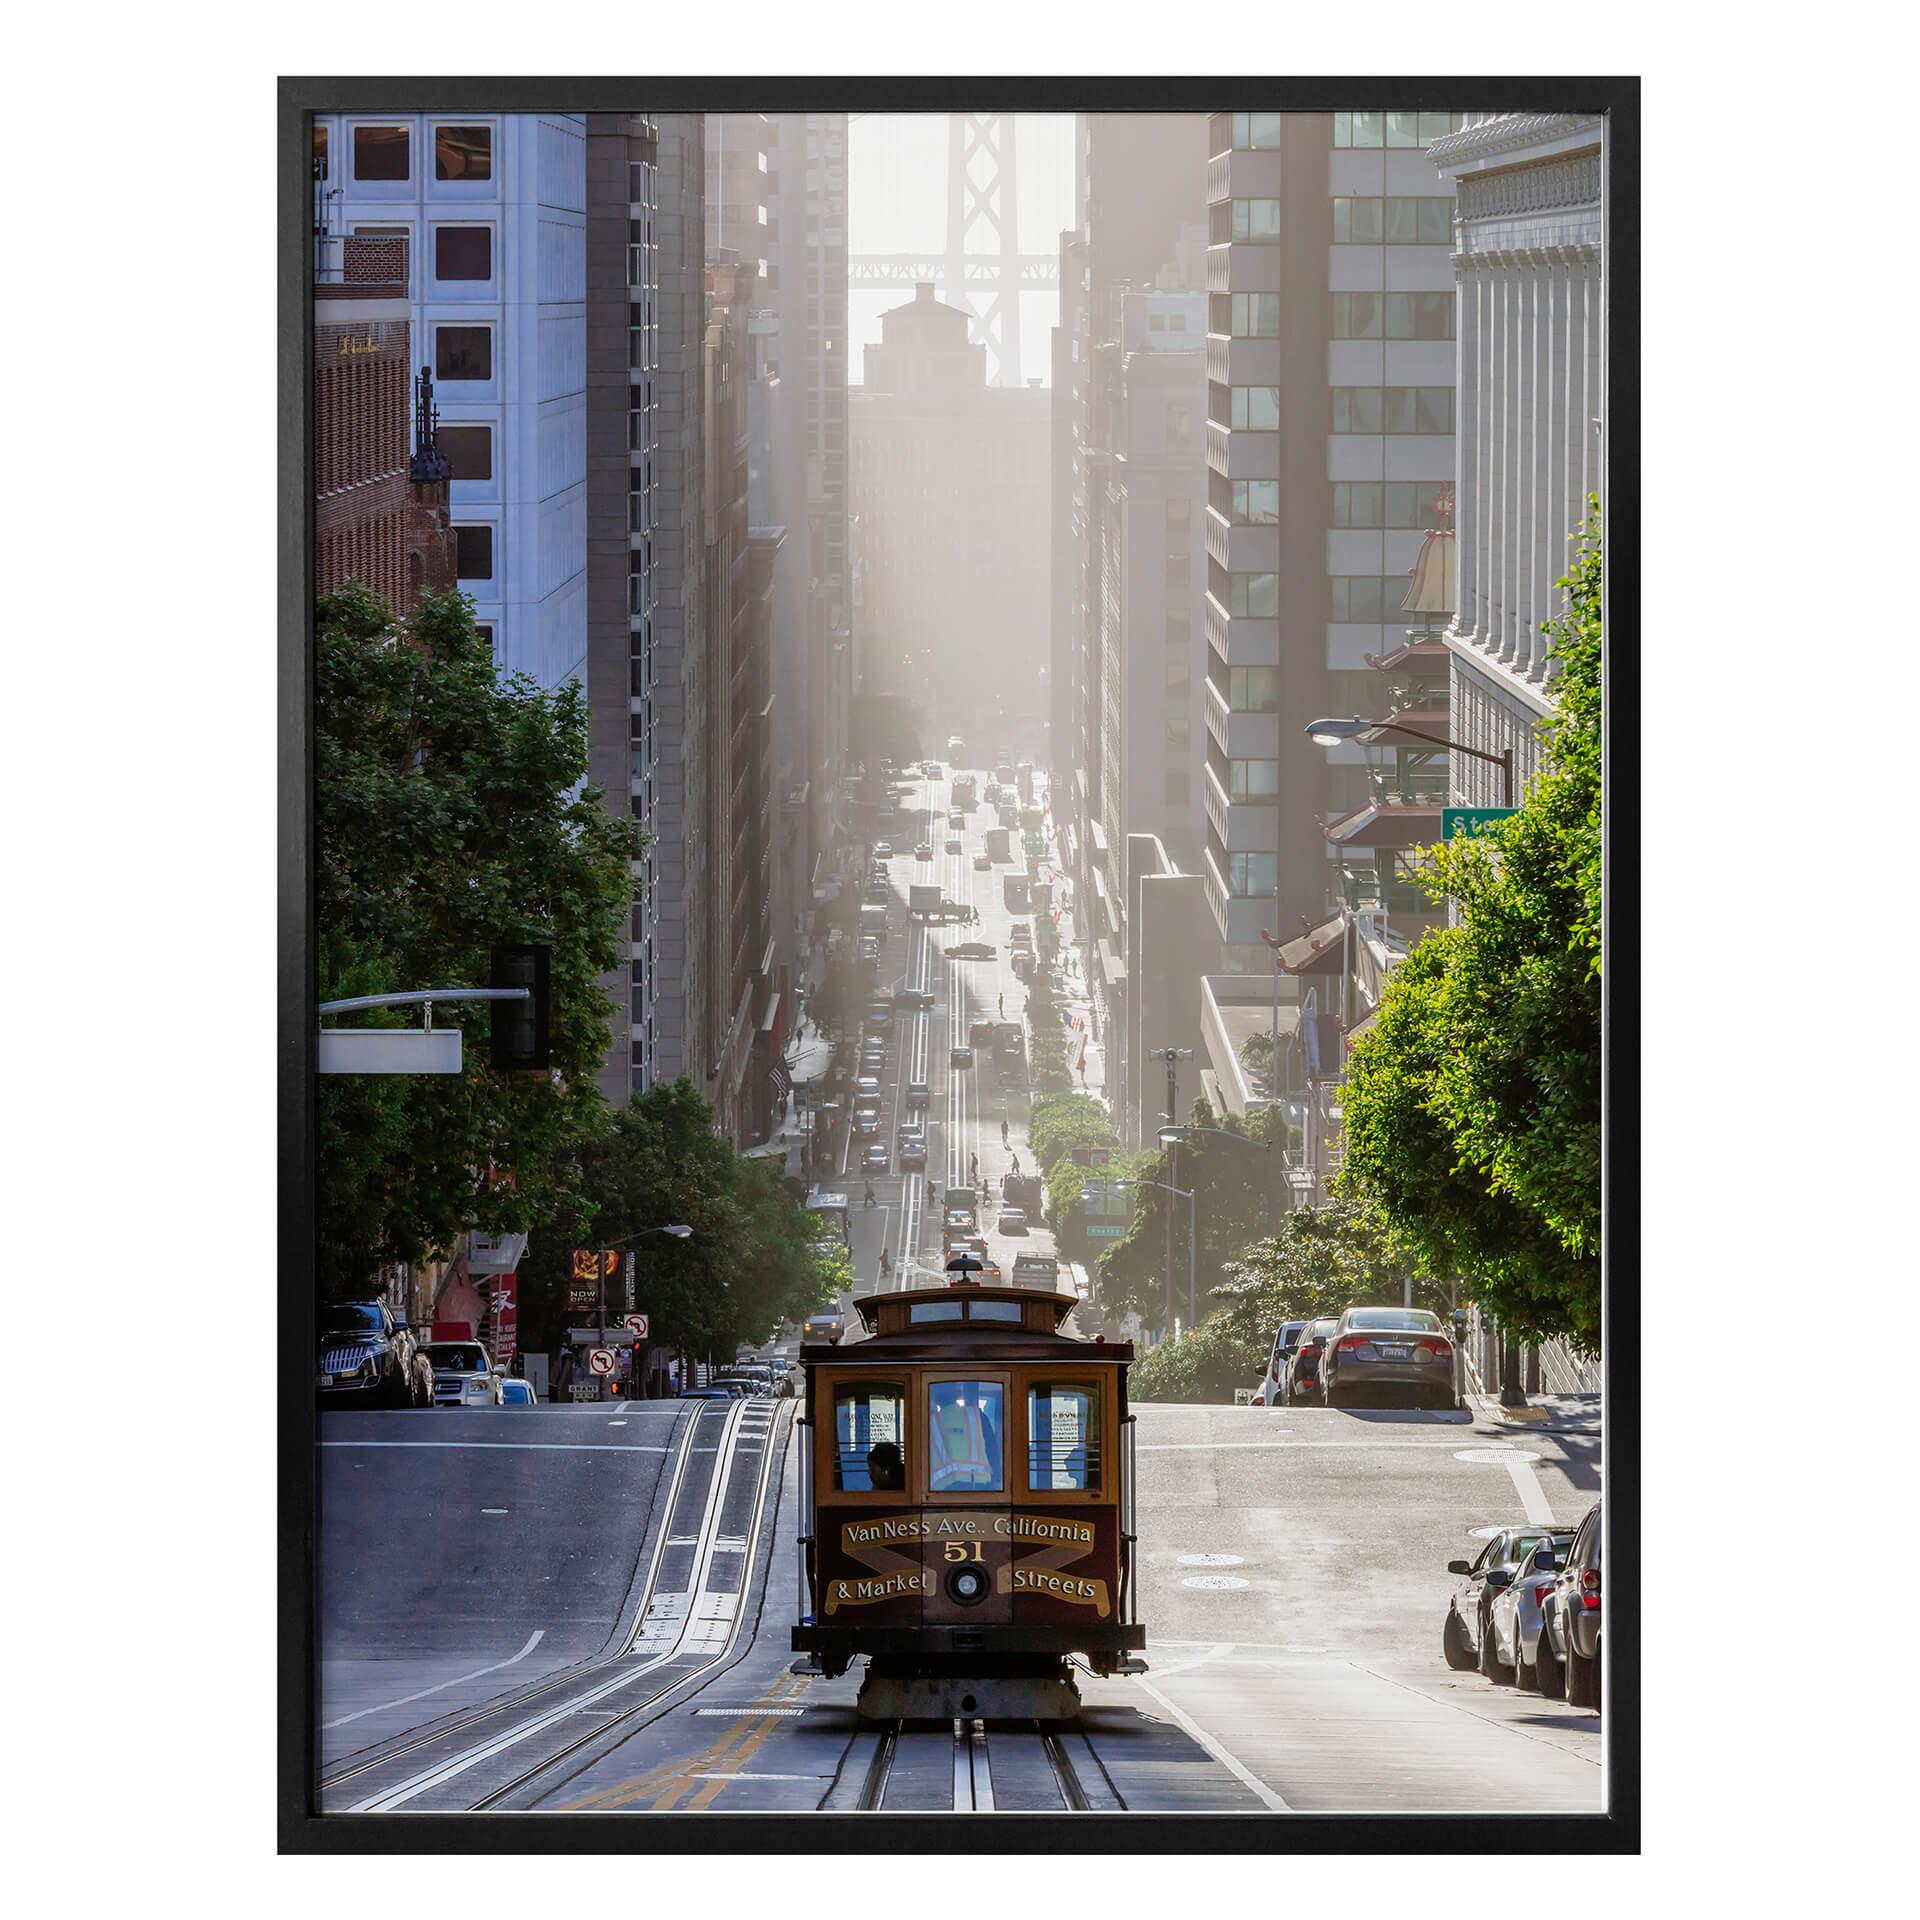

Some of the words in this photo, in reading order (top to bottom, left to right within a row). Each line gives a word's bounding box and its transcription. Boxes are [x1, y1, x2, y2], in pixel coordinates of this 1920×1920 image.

[848, 1525, 881, 1543] Van
[883, 1519, 931, 1538] Ness
[994, 1518, 1091, 1543] California
[943, 1541, 986, 1562] 51
[838, 1582, 852, 1599] &
[857, 1573, 927, 1599] Market
[1014, 1570, 1096, 1597] Streets
